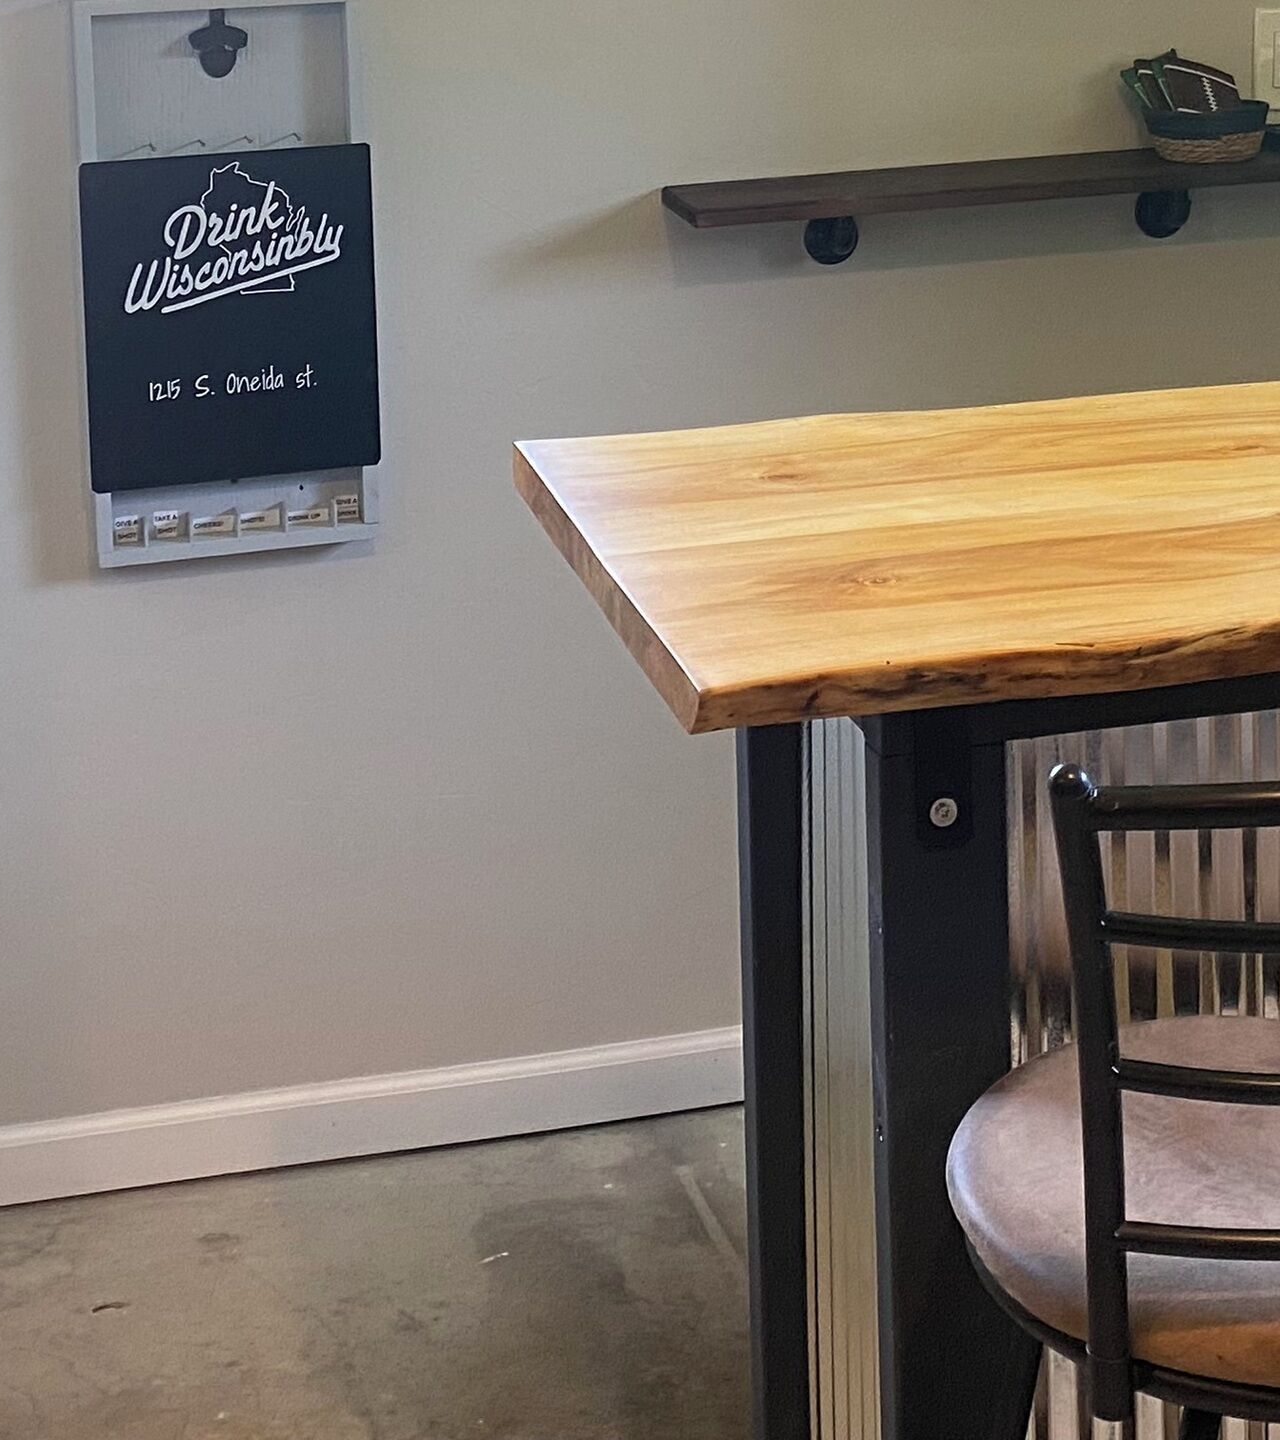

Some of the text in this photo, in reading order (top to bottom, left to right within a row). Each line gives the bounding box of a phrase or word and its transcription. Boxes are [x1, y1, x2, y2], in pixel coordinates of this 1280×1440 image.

[164, 180, 285, 260] Drink
[124, 213, 344, 314] Wisconsinbly
[149, 364, 317, 402] 1215 S. Oneida st.
[115, 520, 131, 528] GIVE
